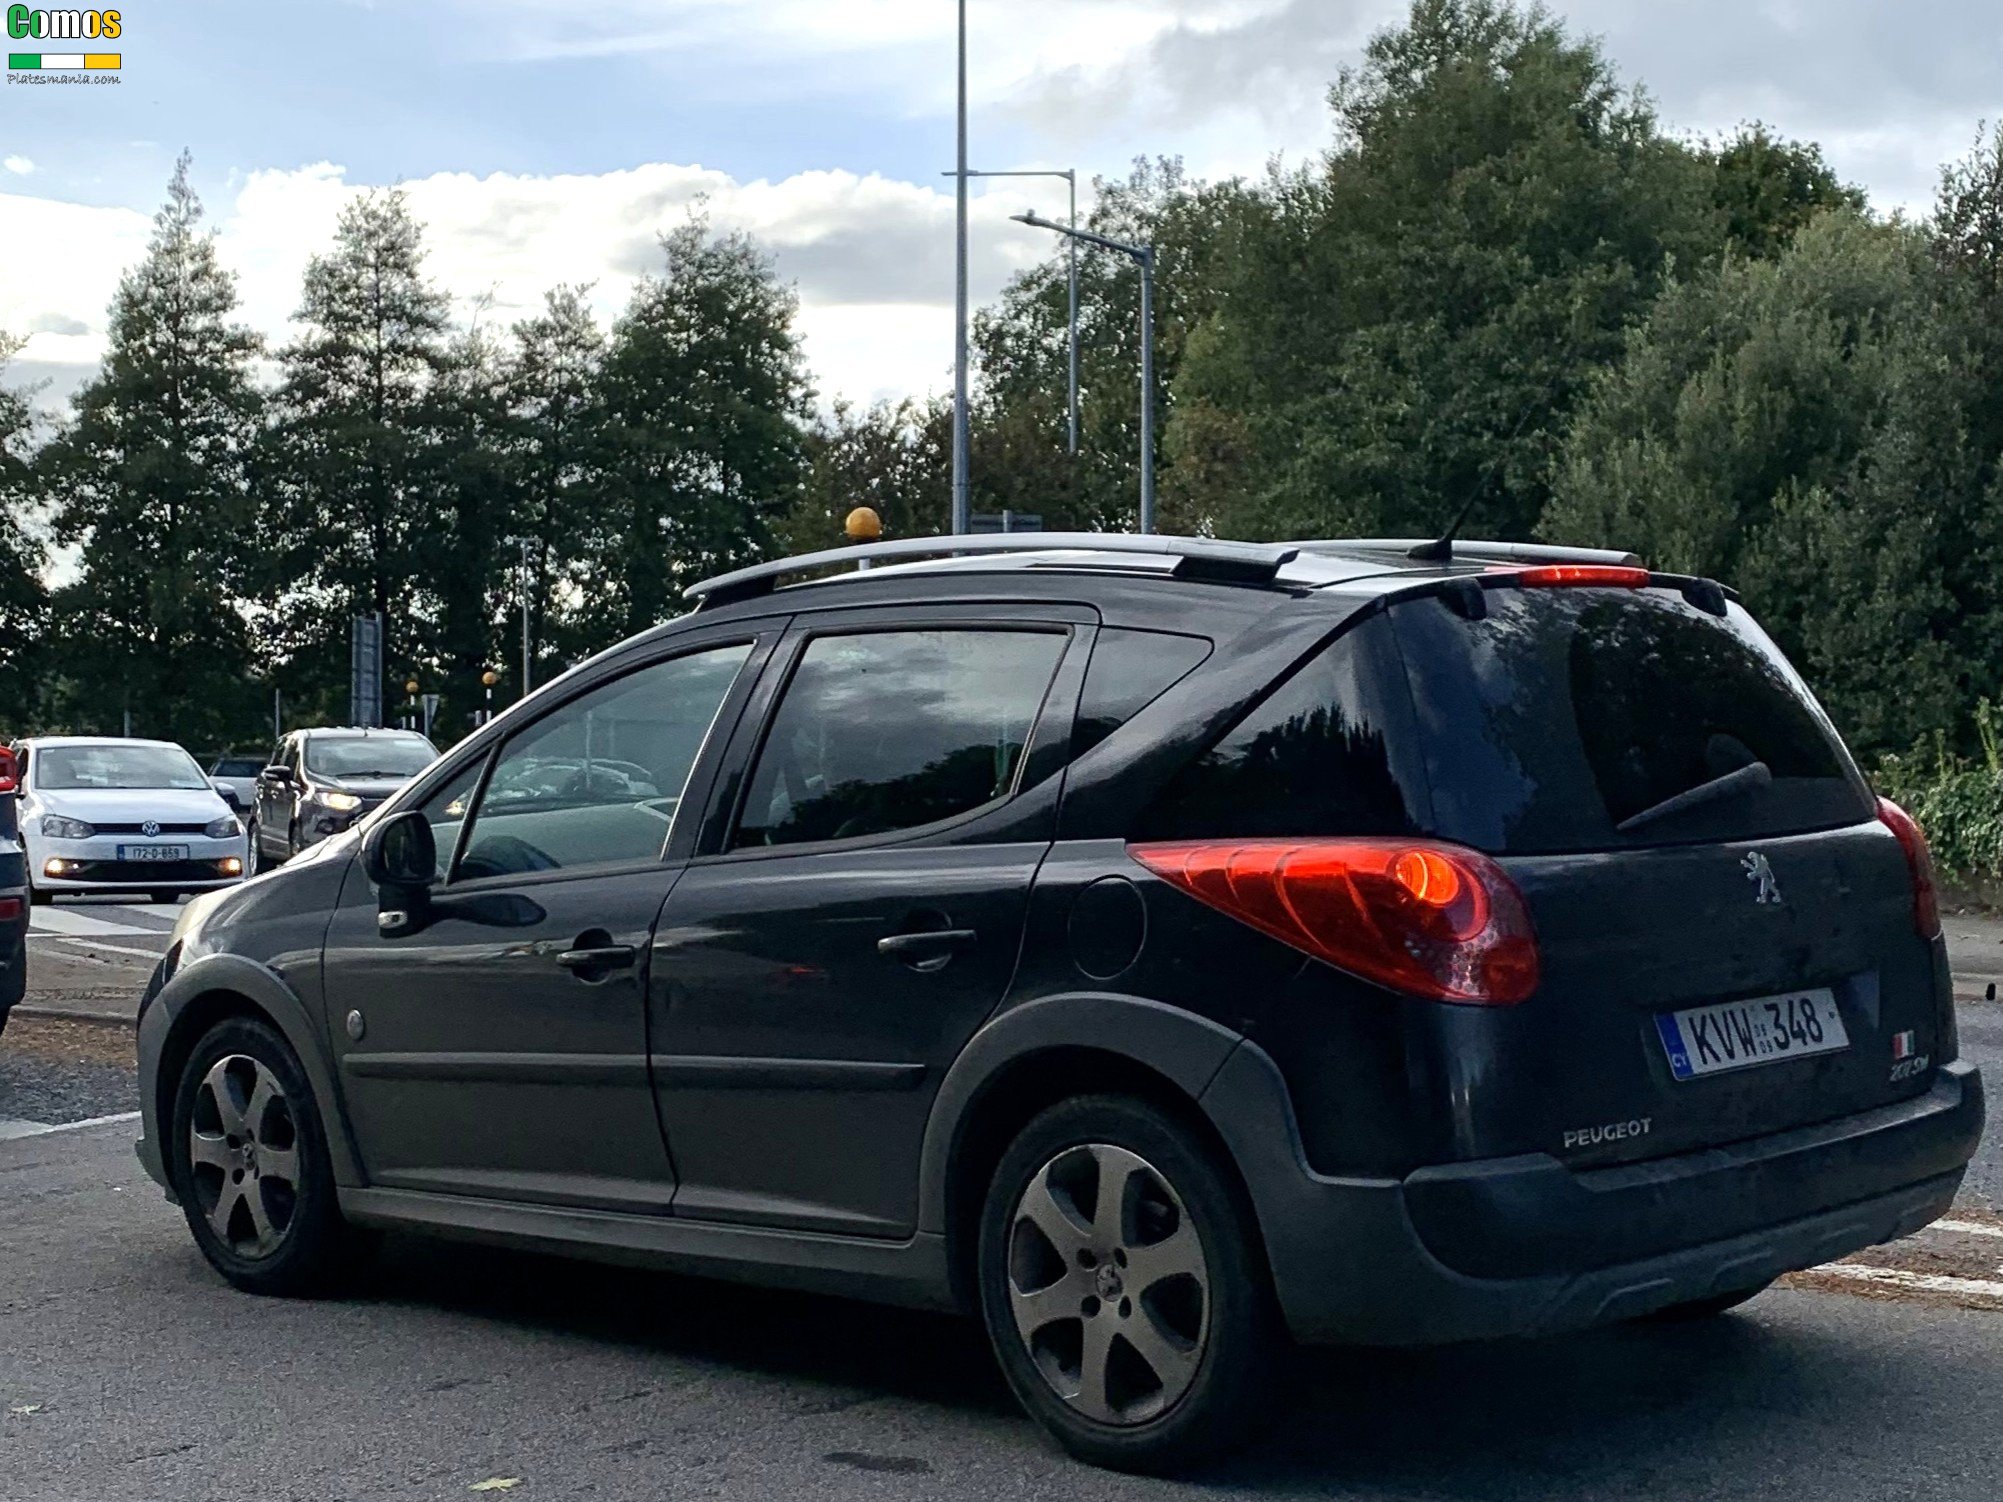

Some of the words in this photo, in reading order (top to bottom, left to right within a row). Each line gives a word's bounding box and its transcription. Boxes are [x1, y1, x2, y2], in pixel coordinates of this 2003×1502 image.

[1689, 1007, 1757, 1065] KVW
[1765, 998, 1824, 1051] 348
[1671, 1052, 1687, 1068] CY
[1563, 1117, 1652, 1148] PEUGEOT
